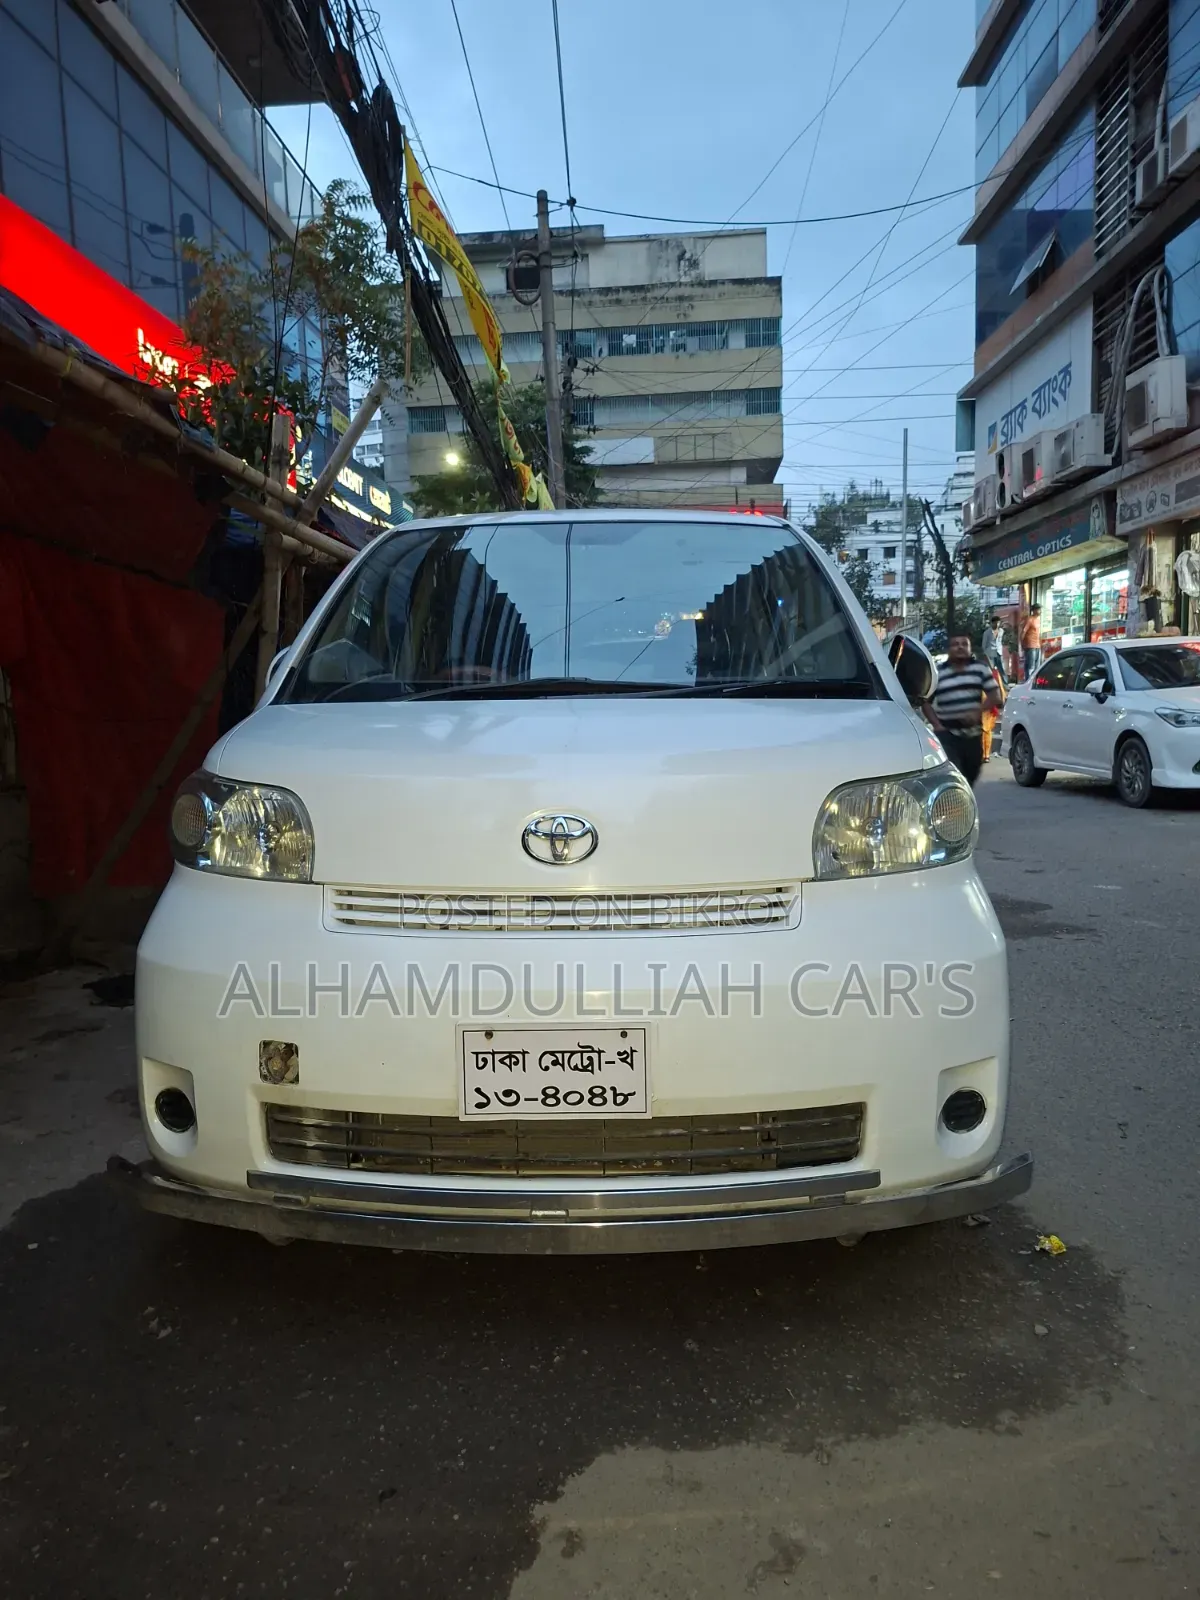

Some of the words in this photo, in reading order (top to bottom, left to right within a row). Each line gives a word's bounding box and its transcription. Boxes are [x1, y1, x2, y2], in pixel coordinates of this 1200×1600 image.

[1032, 361, 1072, 420] ব্যাংক
[998, 549, 1034, 570] CENTRAL
[1036, 534, 1072, 557] OPTICS
[471, 1049, 530, 1073] ঢাকা
[538, 1042, 638, 1075] মেট্রো-খ
[474, 1085, 636, 1109] ১৩-৪০৪৮
